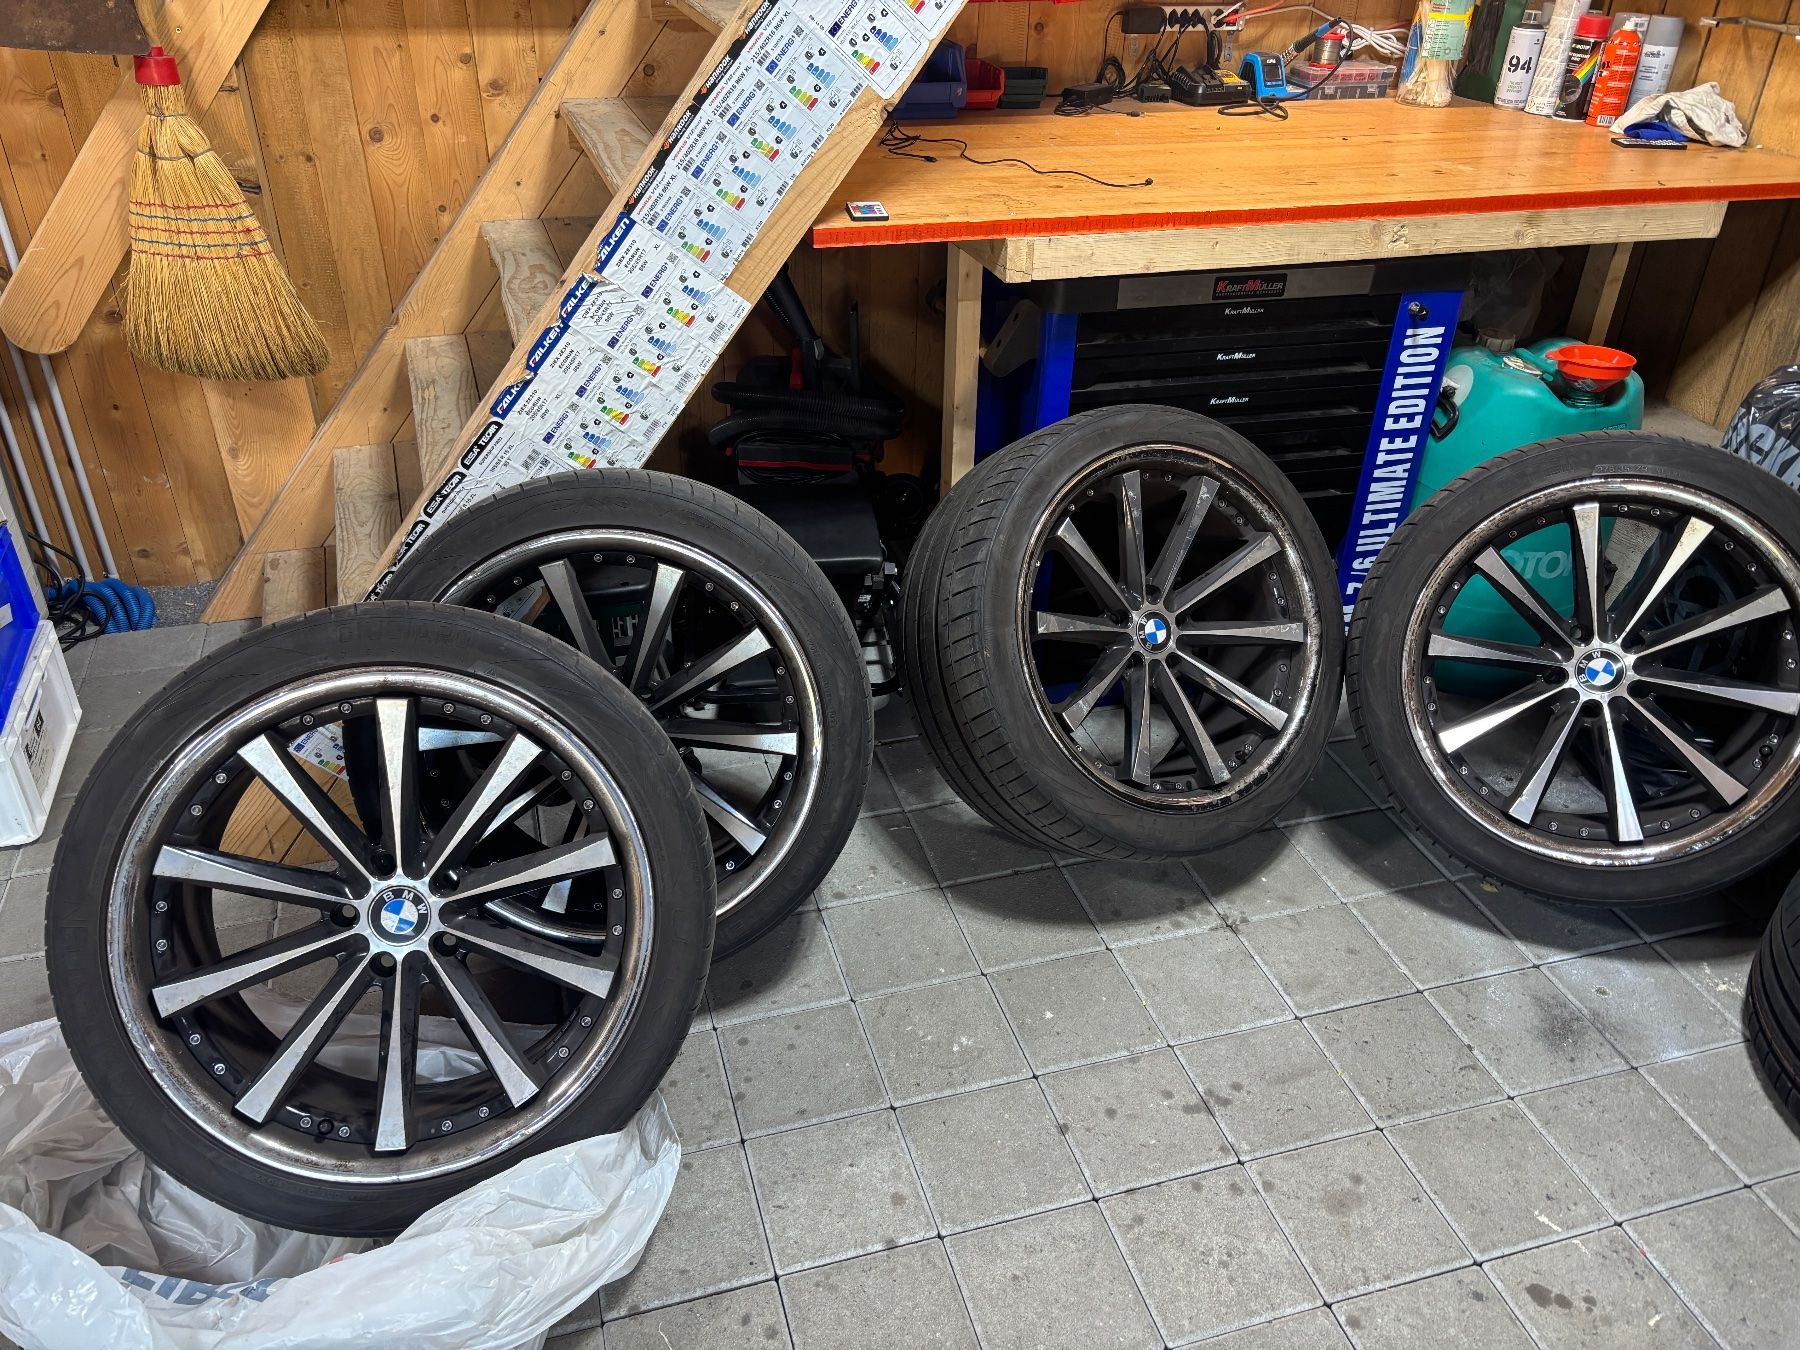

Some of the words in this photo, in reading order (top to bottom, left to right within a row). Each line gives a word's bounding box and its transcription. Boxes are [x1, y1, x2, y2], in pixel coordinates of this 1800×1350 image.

[782, 9, 791, 18] XL
[774, 37, 795, 62] ENERG
[743, 64, 751, 72] XL
[1507, 54, 1533, 74] 94
[735, 91, 756, 115] ENERG
[705, 118, 712, 126] XL
[699, 143, 718, 167] ENERG
[669, 172, 677, 181] XL
[664, 197, 683, 221] ENERG
[649, 264, 667, 287] ENERG
[560, 278, 591, 317] FALKE
[583, 365, 601, 387] ENERG
[1384, 326, 1446, 431] EDITION
[495, 380, 523, 414] FALK
[478, 423, 498, 447] TECAR
[440, 473, 461, 496] TECAR
[1356, 435, 1418, 552] ULTIMATE
[406, 521, 425, 544] TECAR
[383, 890, 428, 914] BMW
